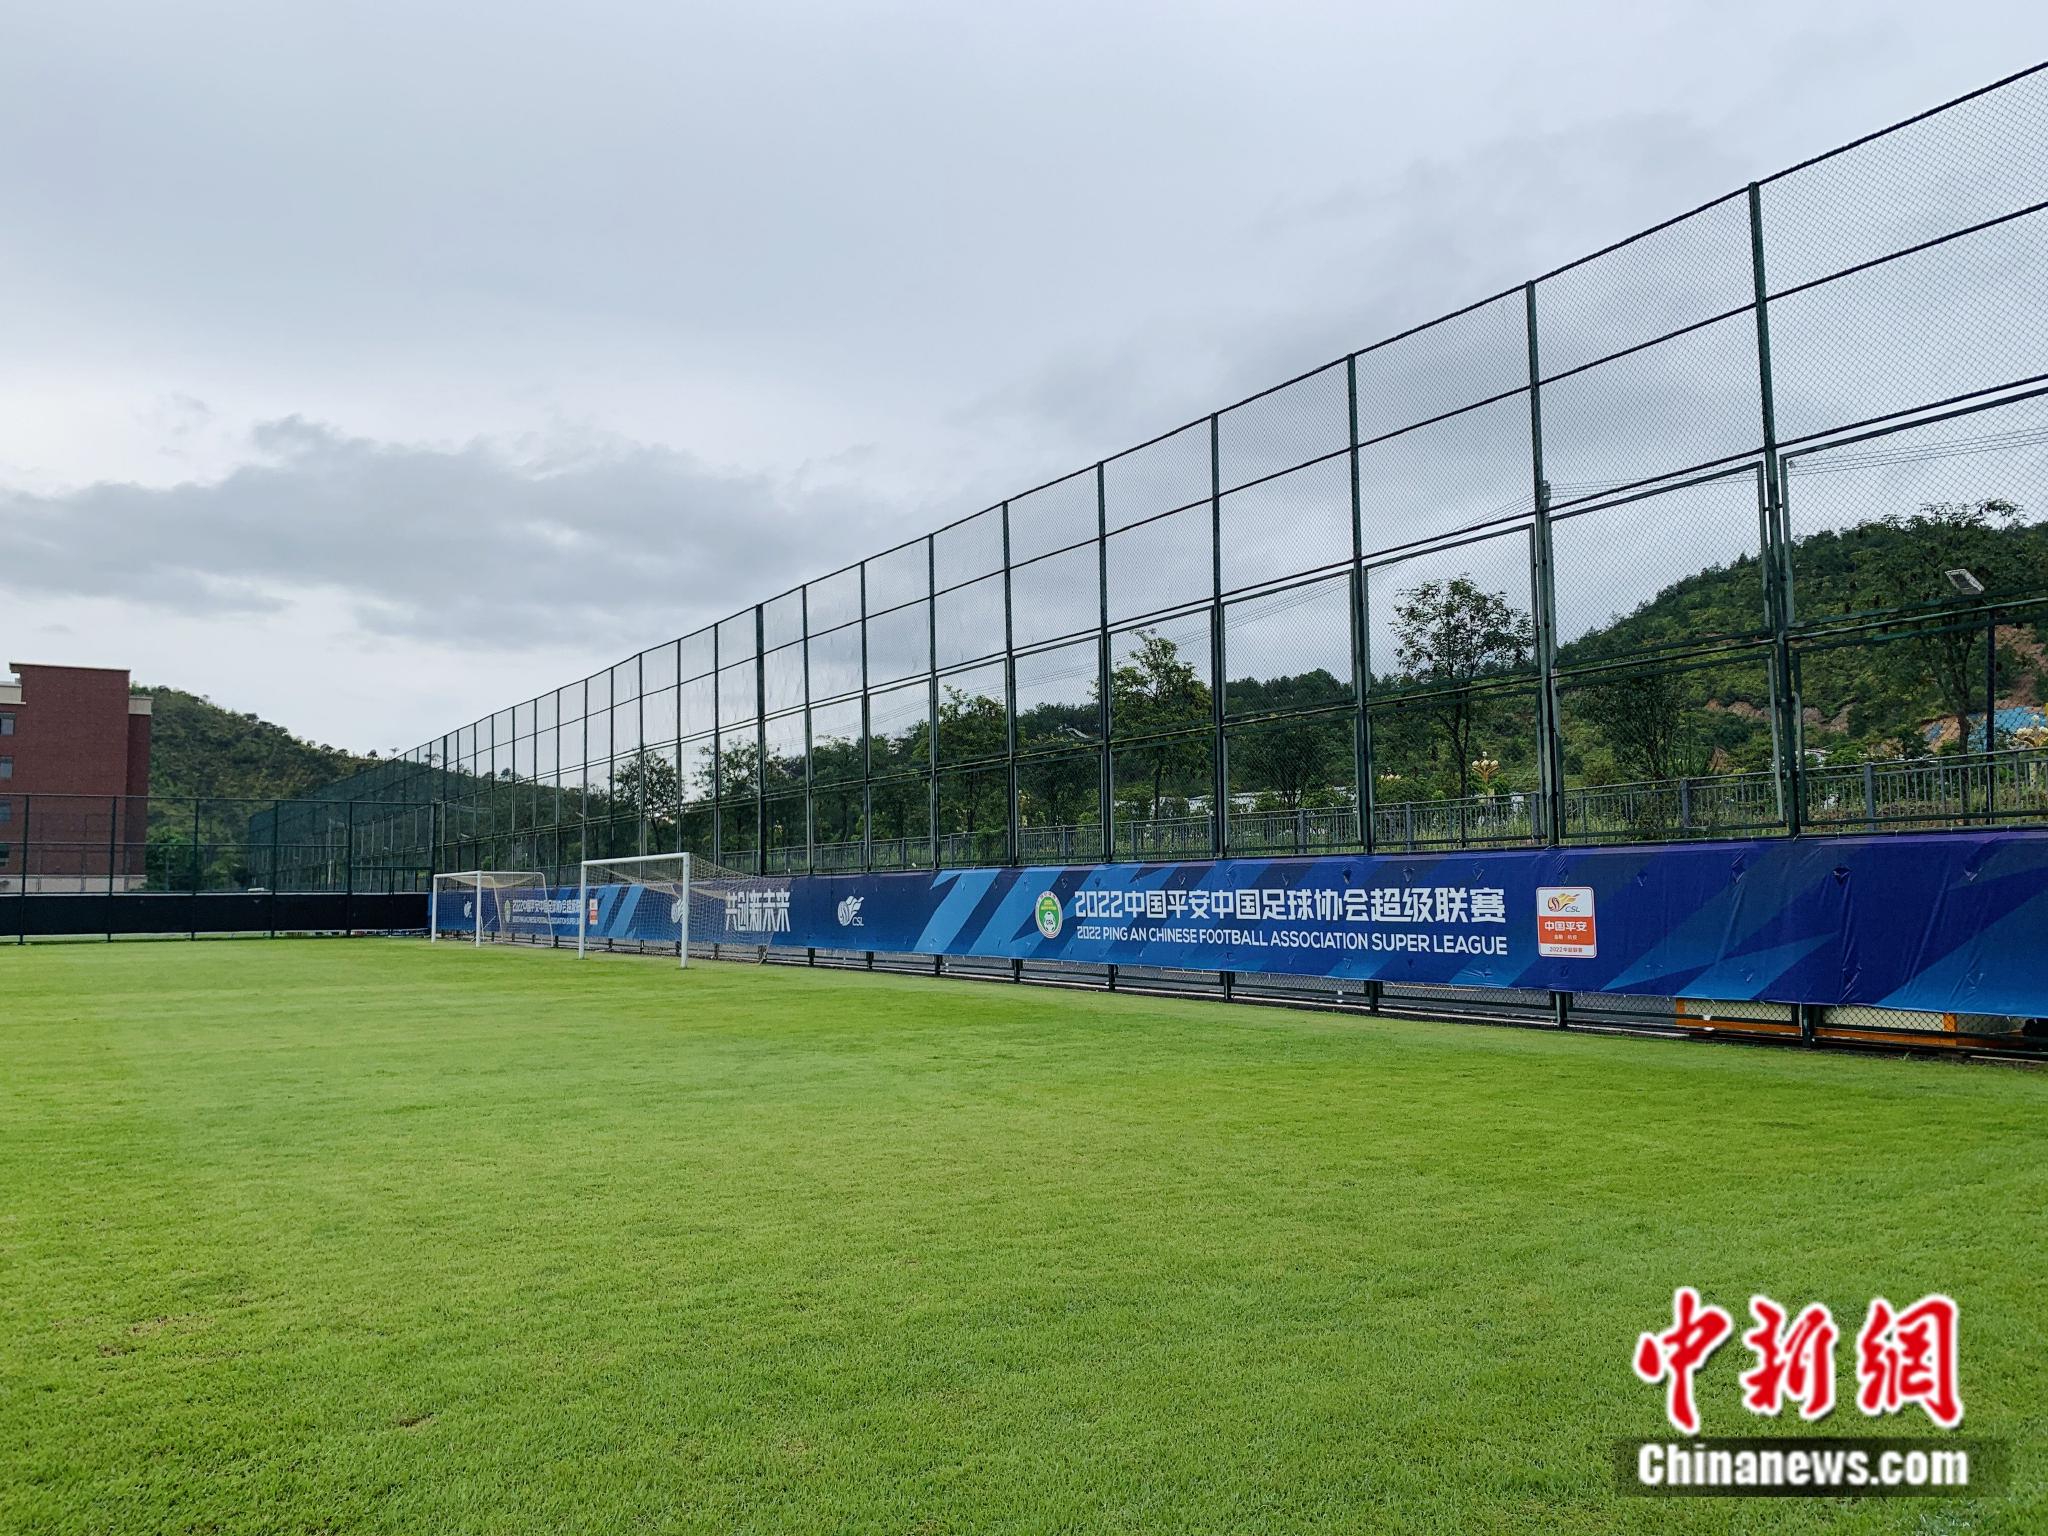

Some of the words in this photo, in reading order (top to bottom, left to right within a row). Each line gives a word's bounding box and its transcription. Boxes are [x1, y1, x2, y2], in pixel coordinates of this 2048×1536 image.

[725, 887, 791, 932] 共创新未来
[1074, 887, 1506, 923] 2022中国平安中国足球协会超级联赛
[1565, 905, 1581, 913] CSL
[852, 916, 864, 927] CSL
[1544, 920, 1588, 932] 中国平安
[1077, 925, 1101, 940] 2022
[1103, 926, 1128, 941] PING
[1129, 927, 1147, 942] AN
[1149, 928, 1198, 944] CHINESE
[1199, 929, 1269, 947] FOOTBALL
[1270, 930, 1369, 950] ASSOCIATION
[1371, 932, 1430, 953] SUPER
[1433, 935, 1508, 955] LEAGUE
